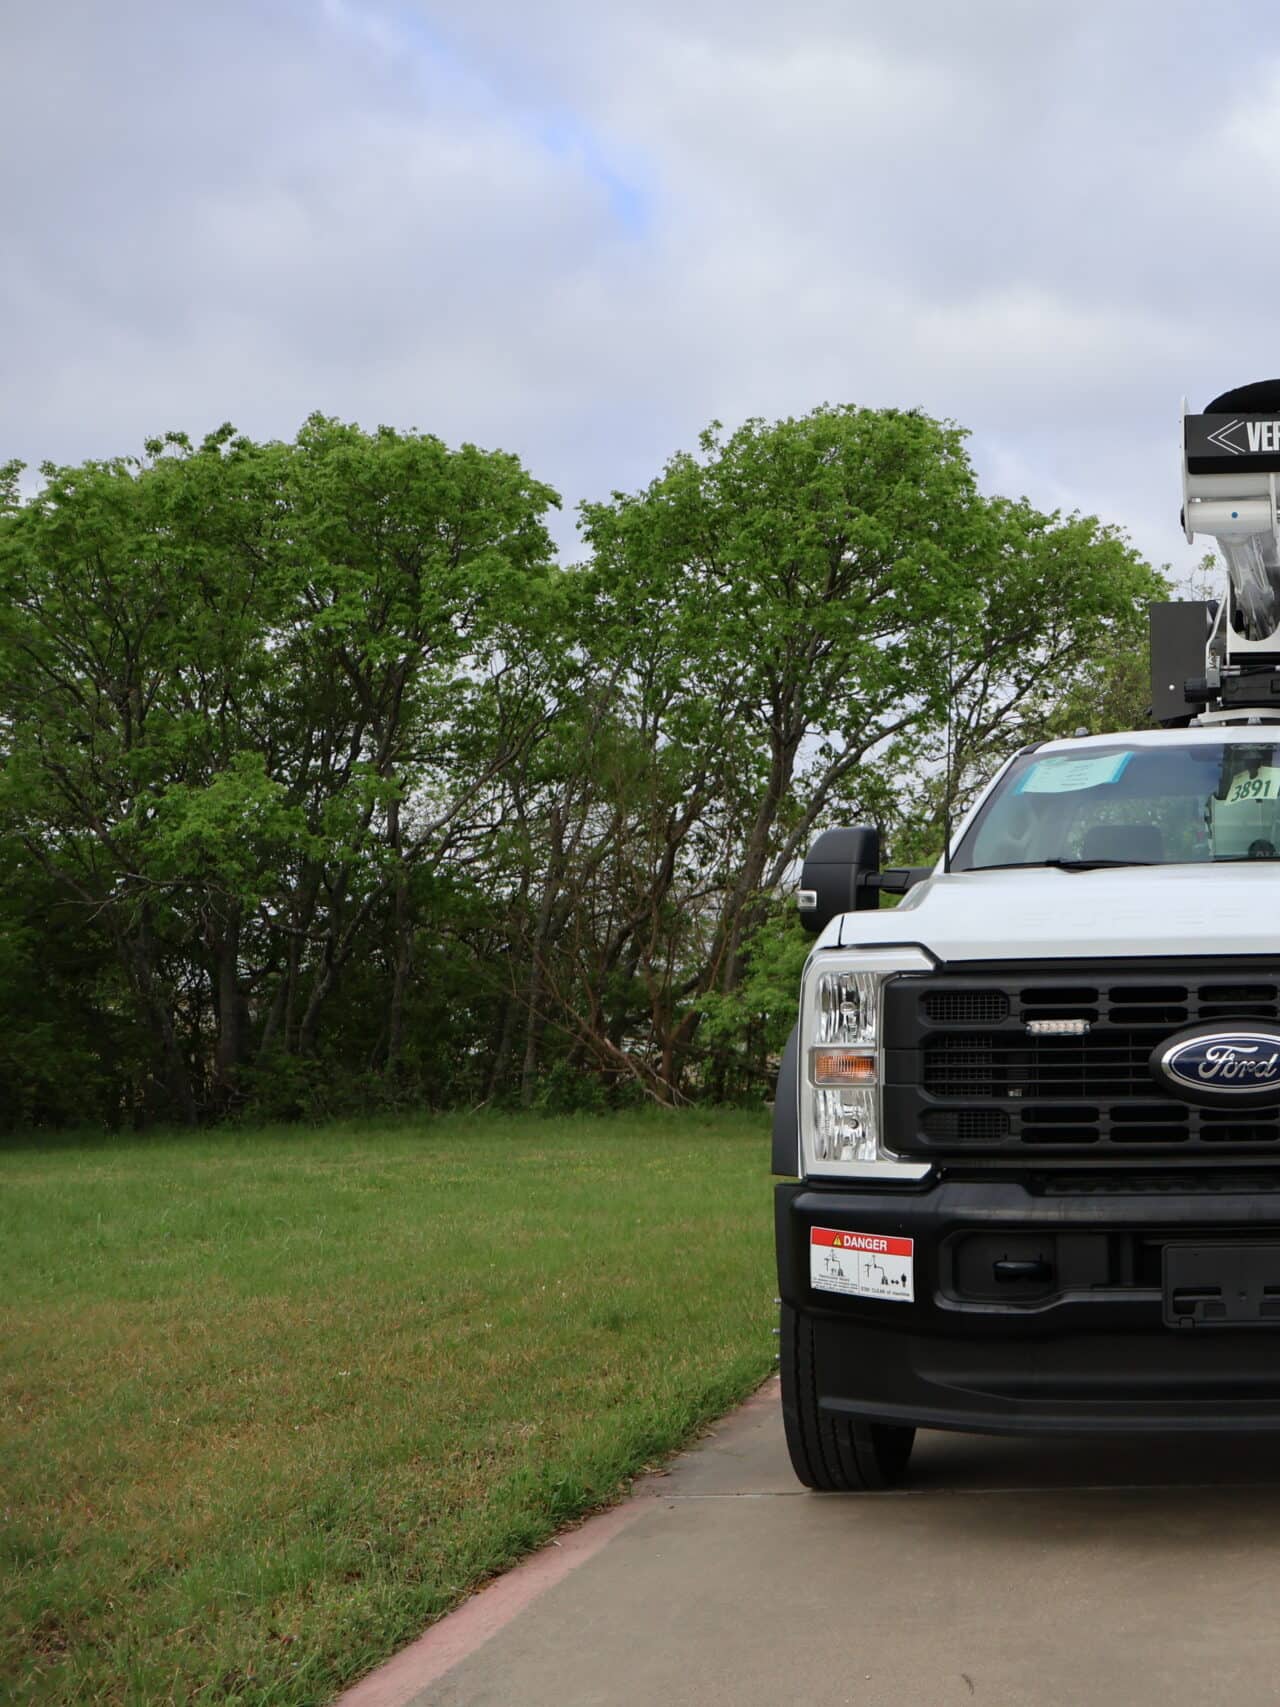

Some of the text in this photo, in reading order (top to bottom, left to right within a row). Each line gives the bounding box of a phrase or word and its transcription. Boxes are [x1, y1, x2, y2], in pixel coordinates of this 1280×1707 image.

[1230, 779, 1271, 803] 3891
[1198, 1045, 1279, 1079] Ford
[843, 1235, 888, 1251] DANGER
